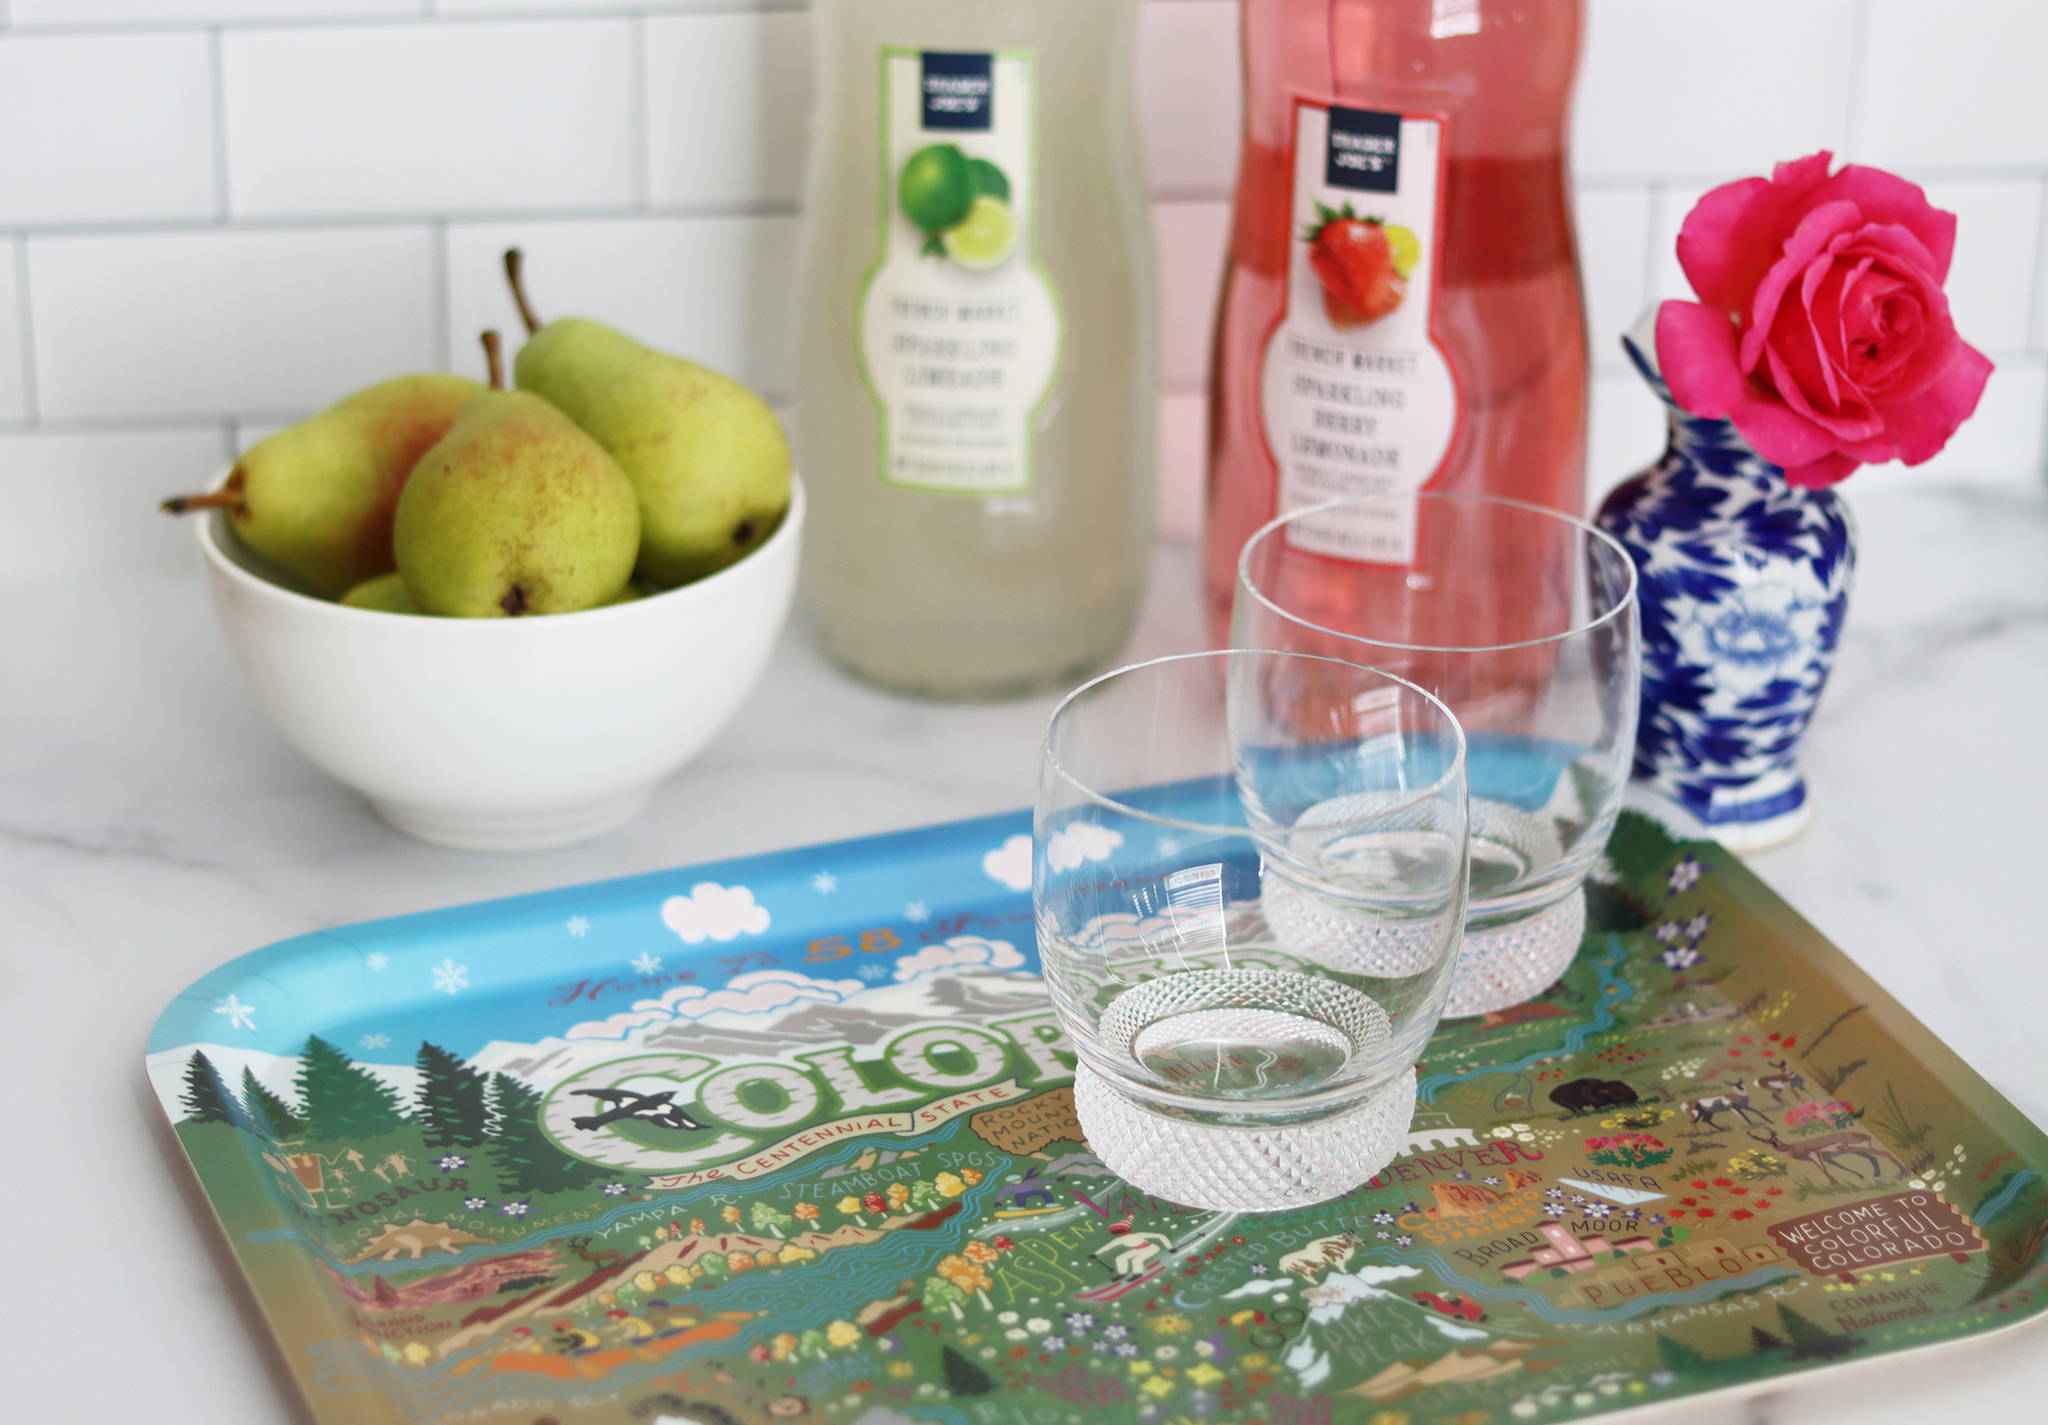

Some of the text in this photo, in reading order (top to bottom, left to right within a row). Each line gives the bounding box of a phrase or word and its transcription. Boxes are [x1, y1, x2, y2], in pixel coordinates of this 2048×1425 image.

[802, 928, 902, 963] 58
[978, 1092, 1063, 1127] ROCKY
[992, 1104, 1072, 1140] MOUNT
[659, 1087, 1010, 1188] The CENTENNIAL STATE
[1012, 1117, 1078, 1149] NATIO
[782, 1152, 997, 1199] STEAMBOAT SPGS
[1362, 1141, 1544, 1189] DENVER
[1572, 1166, 1662, 1191] USAFA
[596, 1205, 688, 1239] YAMPA
[1063, 1189, 1207, 1219] VAIL
[1398, 1190, 1540, 1230] COLORADO
[1779, 1195, 1927, 1245] WELCOME TO
[1454, 1219, 1640, 1267] BROAD MOOR
[1804, 1210, 1951, 1255] COLORFUL
[1812, 1231, 1965, 1270] COLORADO
[997, 1219, 1095, 1303] ASPEN
[1174, 1216, 1368, 1309] CRESTED BUTTE
[1582, 1257, 1743, 1304] PUEBLO
[1585, 1297, 1761, 1335] ARKANSAS
[1829, 1283, 1947, 1314] COMANCHE
[1322, 1304, 1412, 1352] PIKES
[1350, 1328, 1438, 1367] PEAK
